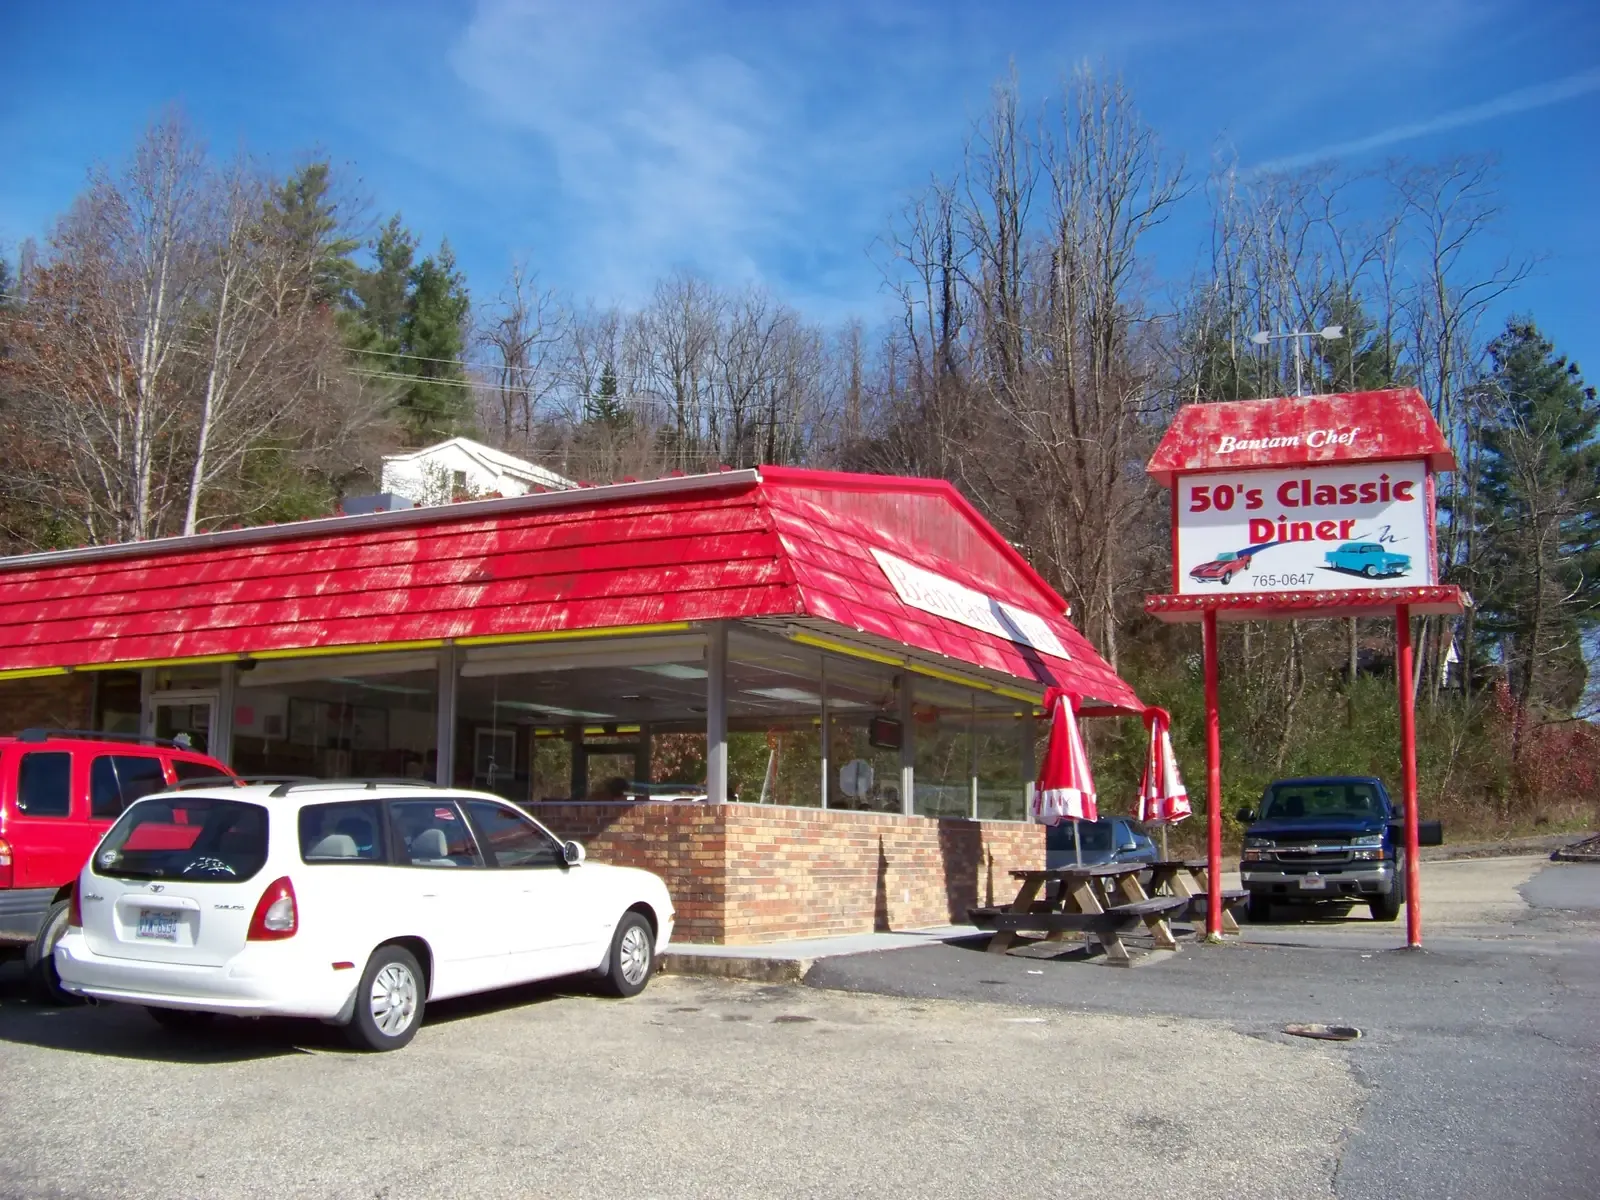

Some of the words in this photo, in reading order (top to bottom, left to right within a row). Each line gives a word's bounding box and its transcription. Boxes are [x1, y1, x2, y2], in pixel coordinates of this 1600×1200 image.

[1216, 436, 1299, 454] Bantam
[1306, 427, 1361, 448] Chef
[1189, 484, 1264, 513] 50's
[1277, 473, 1415, 508] Classic
[1249, 514, 1356, 545] Diner
[1252, 573, 1315, 587] 765-0647
